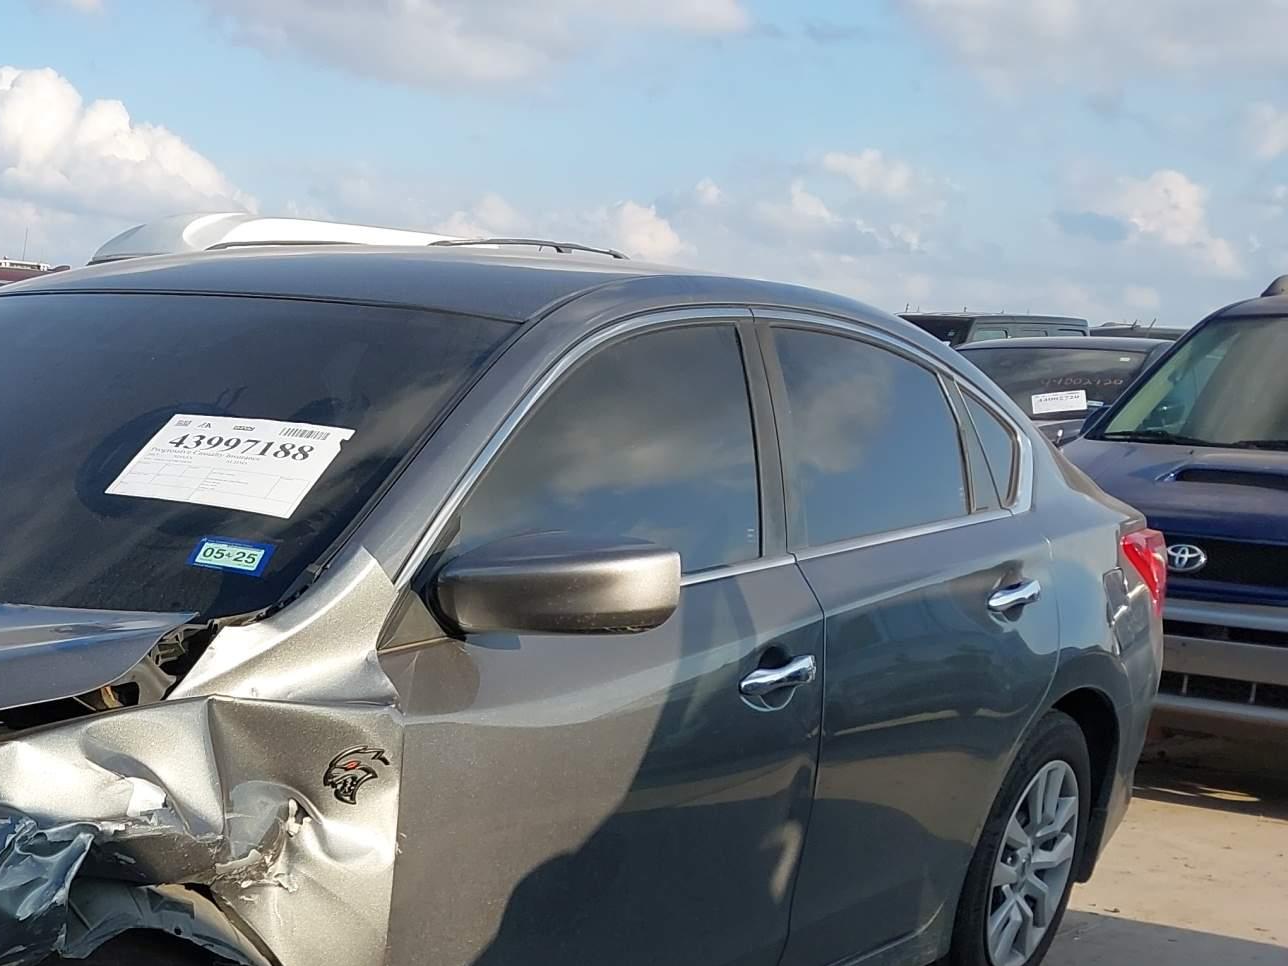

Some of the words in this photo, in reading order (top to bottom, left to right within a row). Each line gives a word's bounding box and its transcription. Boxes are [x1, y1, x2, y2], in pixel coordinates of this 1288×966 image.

[169, 433, 314, 461] 43997188
[203, 547, 227, 560] 05
[232, 551, 258, 564] 25
